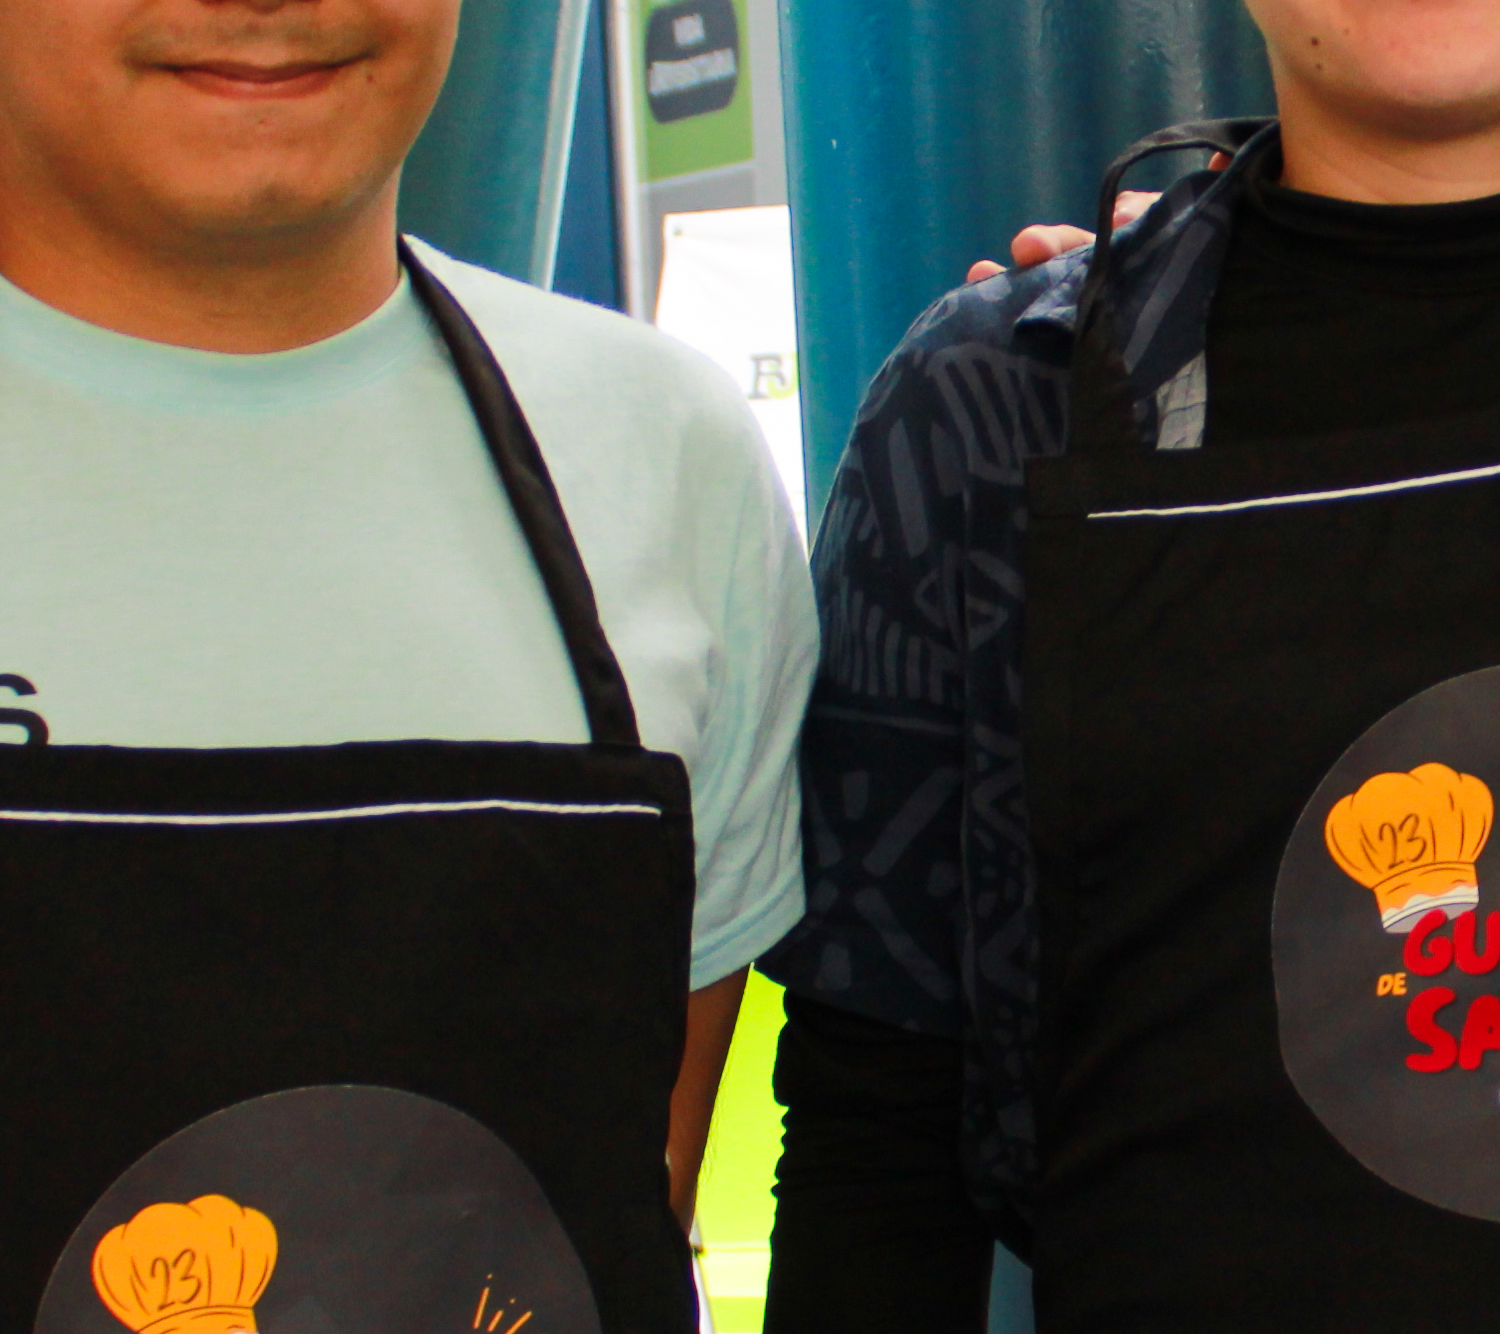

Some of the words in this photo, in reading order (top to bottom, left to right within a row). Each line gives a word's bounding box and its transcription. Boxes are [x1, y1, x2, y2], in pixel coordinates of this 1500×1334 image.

[1378, 812, 1429, 869] 23
[1376, 972, 1408, 996] DE
[151, 1247, 202, 1311] 23
